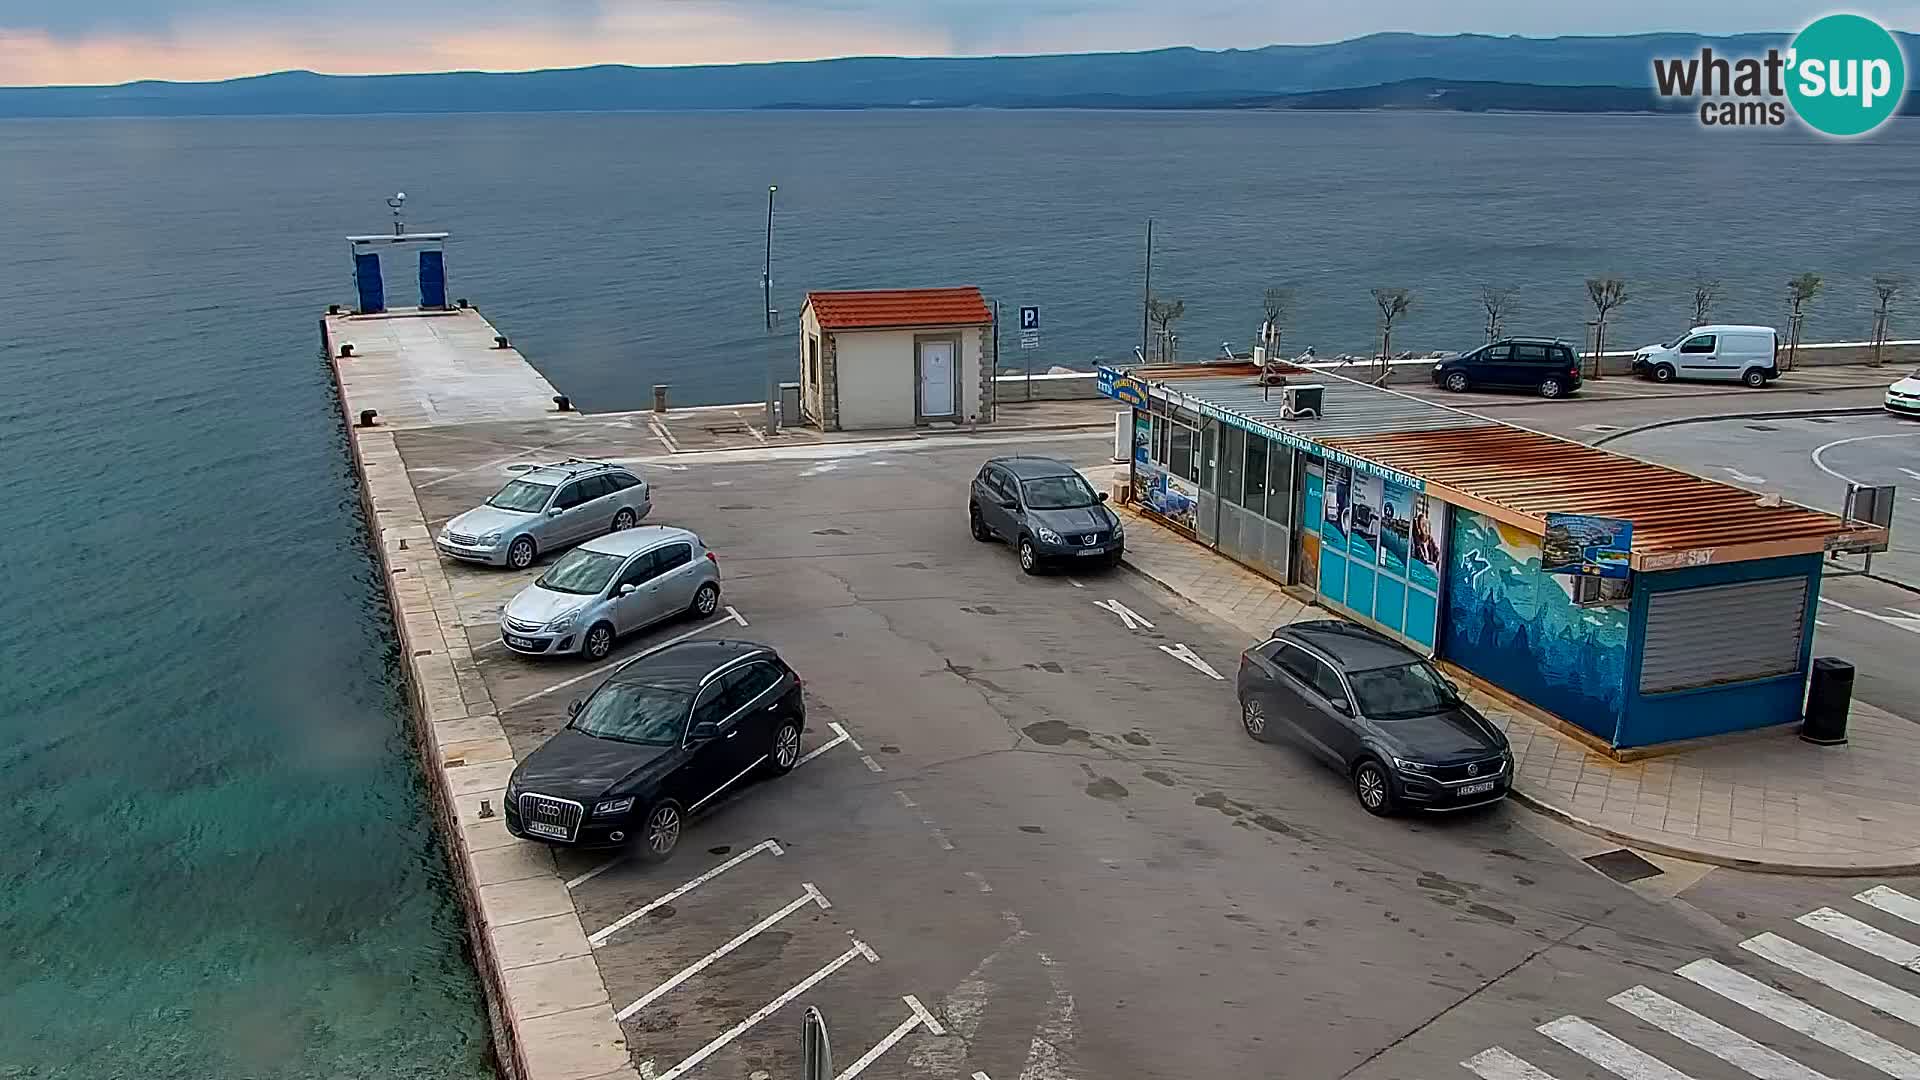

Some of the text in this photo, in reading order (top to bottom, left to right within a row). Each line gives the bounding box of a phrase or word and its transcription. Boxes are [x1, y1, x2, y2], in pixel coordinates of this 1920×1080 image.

[1024, 309, 1035, 326] P
[1283, 434, 1312, 452] POSTAJA
[1321, 446, 1336, 460] BUS
[1336, 452, 1367, 472] STATION
[1369, 463, 1394, 480] TICKET
[1395, 471, 1421, 490] OFFICE
